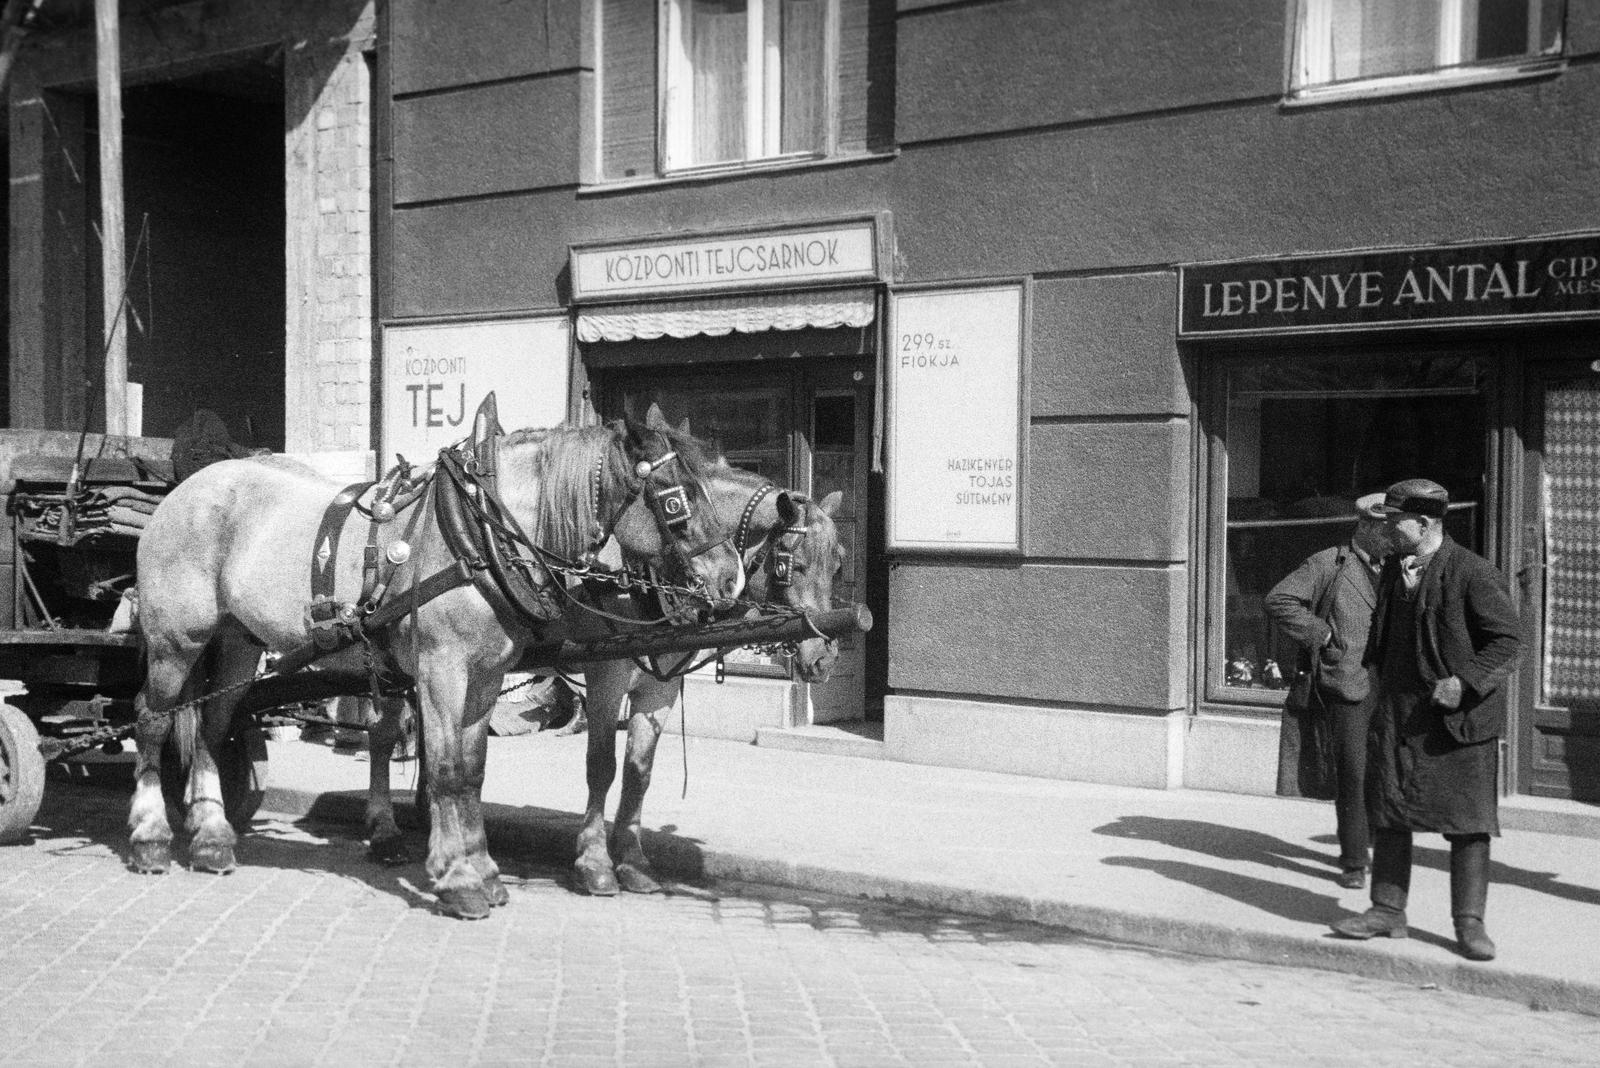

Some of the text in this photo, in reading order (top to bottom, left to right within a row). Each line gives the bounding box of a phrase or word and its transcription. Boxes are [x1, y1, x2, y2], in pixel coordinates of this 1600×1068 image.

[704, 238, 839, 275] TEJCSARNOK
[1202, 270, 1384, 317] LEPENYE
[405, 382, 465, 428] TEJ
